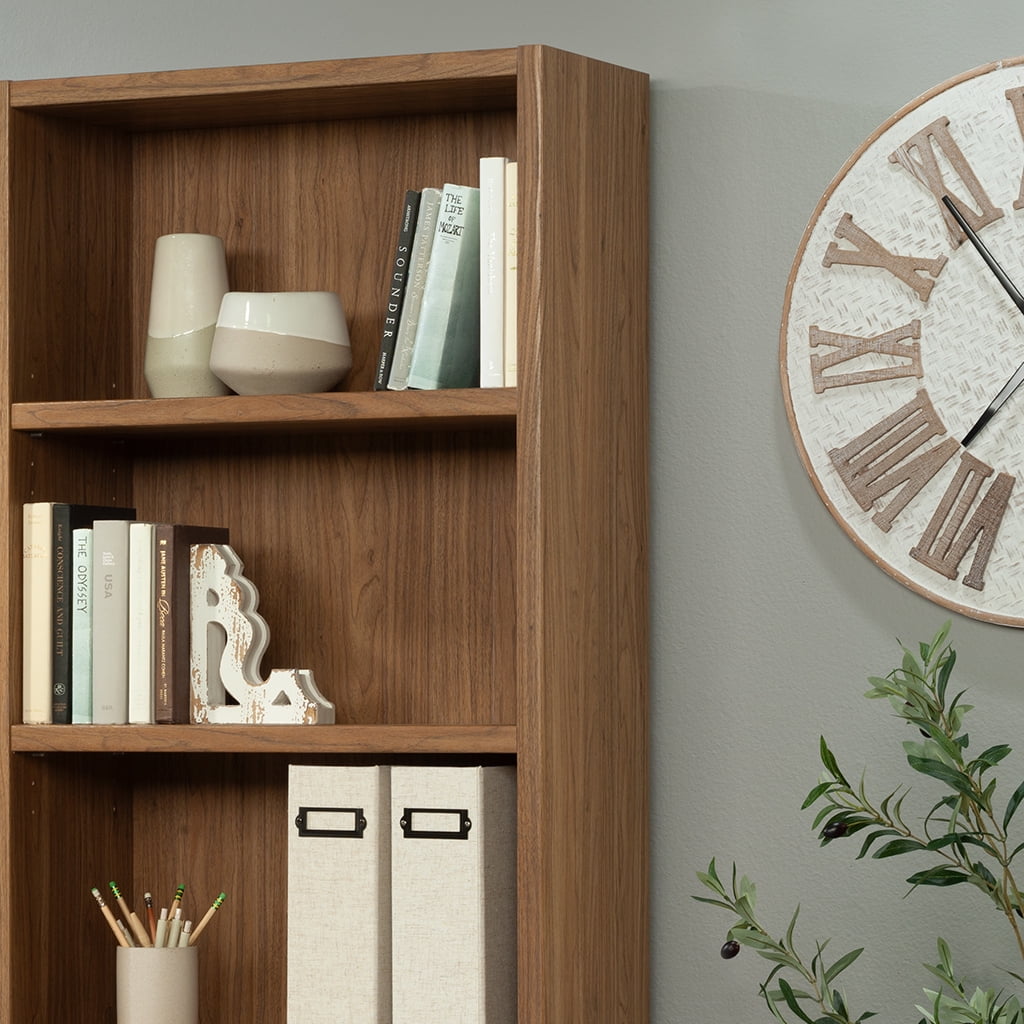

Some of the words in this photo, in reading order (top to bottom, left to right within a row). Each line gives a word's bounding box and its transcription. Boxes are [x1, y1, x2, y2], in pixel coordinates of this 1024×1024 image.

[445, 193, 462, 204] THE
[888, 115, 1005, 250] XI
[403, 205, 411, 232] ARMSTRONG
[422, 202, 434, 231] JAMES
[438, 222, 464, 236] MOZART
[444, 204, 464, 215] LIFE
[412, 234, 431, 288] PATTERSON
[822, 212, 949, 302] X
[384, 246, 408, 338] SOUNDER
[808, 319, 924, 394] IX
[827, 388, 962, 534] VIII
[909, 450, 1016, 592] VII
[77, 536, 88, 558] THE
[56, 546, 64, 603] CONSCIENCE
[76, 565, 88, 614] ODYSSEY
[104, 574, 113, 599] USA
